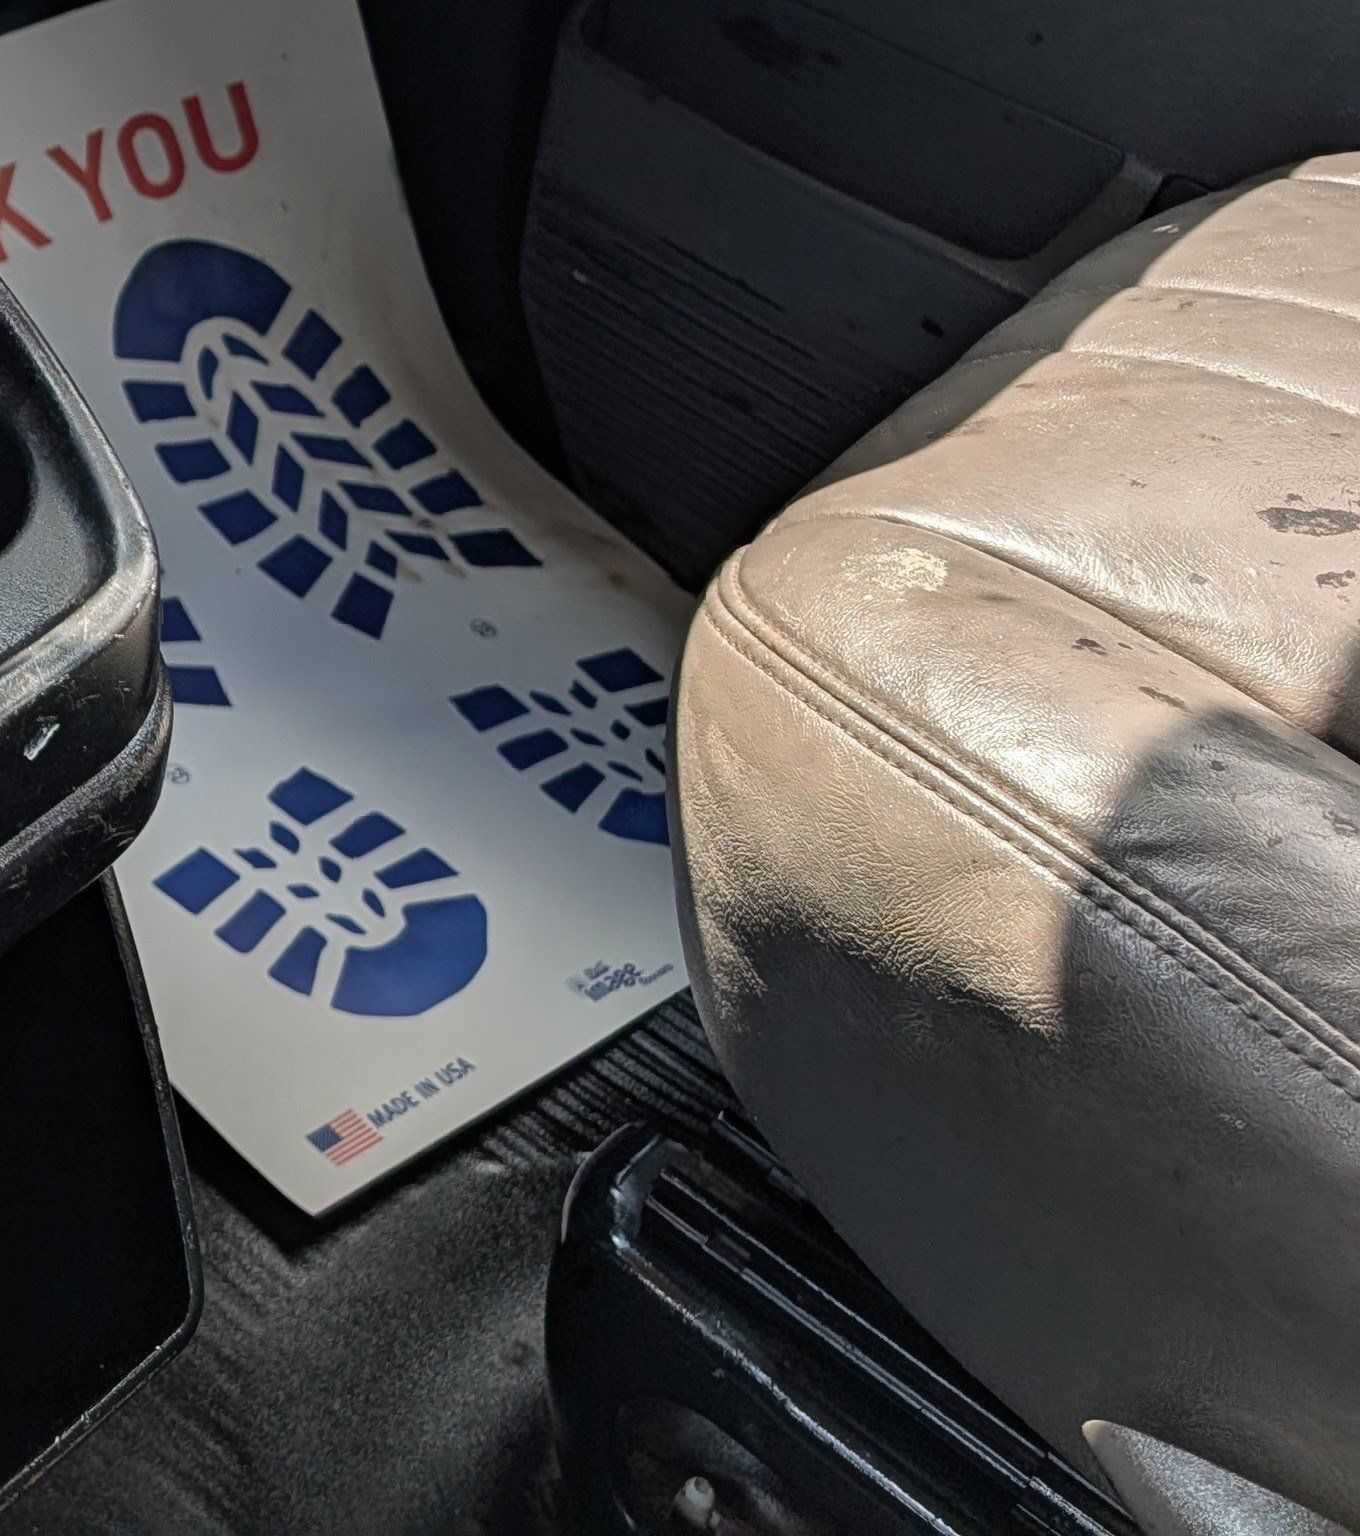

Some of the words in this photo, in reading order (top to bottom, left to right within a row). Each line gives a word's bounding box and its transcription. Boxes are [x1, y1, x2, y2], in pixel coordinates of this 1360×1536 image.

[44, 79, 260, 223] YOU
[366, 1090, 420, 1129] MADE
[414, 1077, 441, 1100] IN
[434, 1056, 477, 1086] USA
